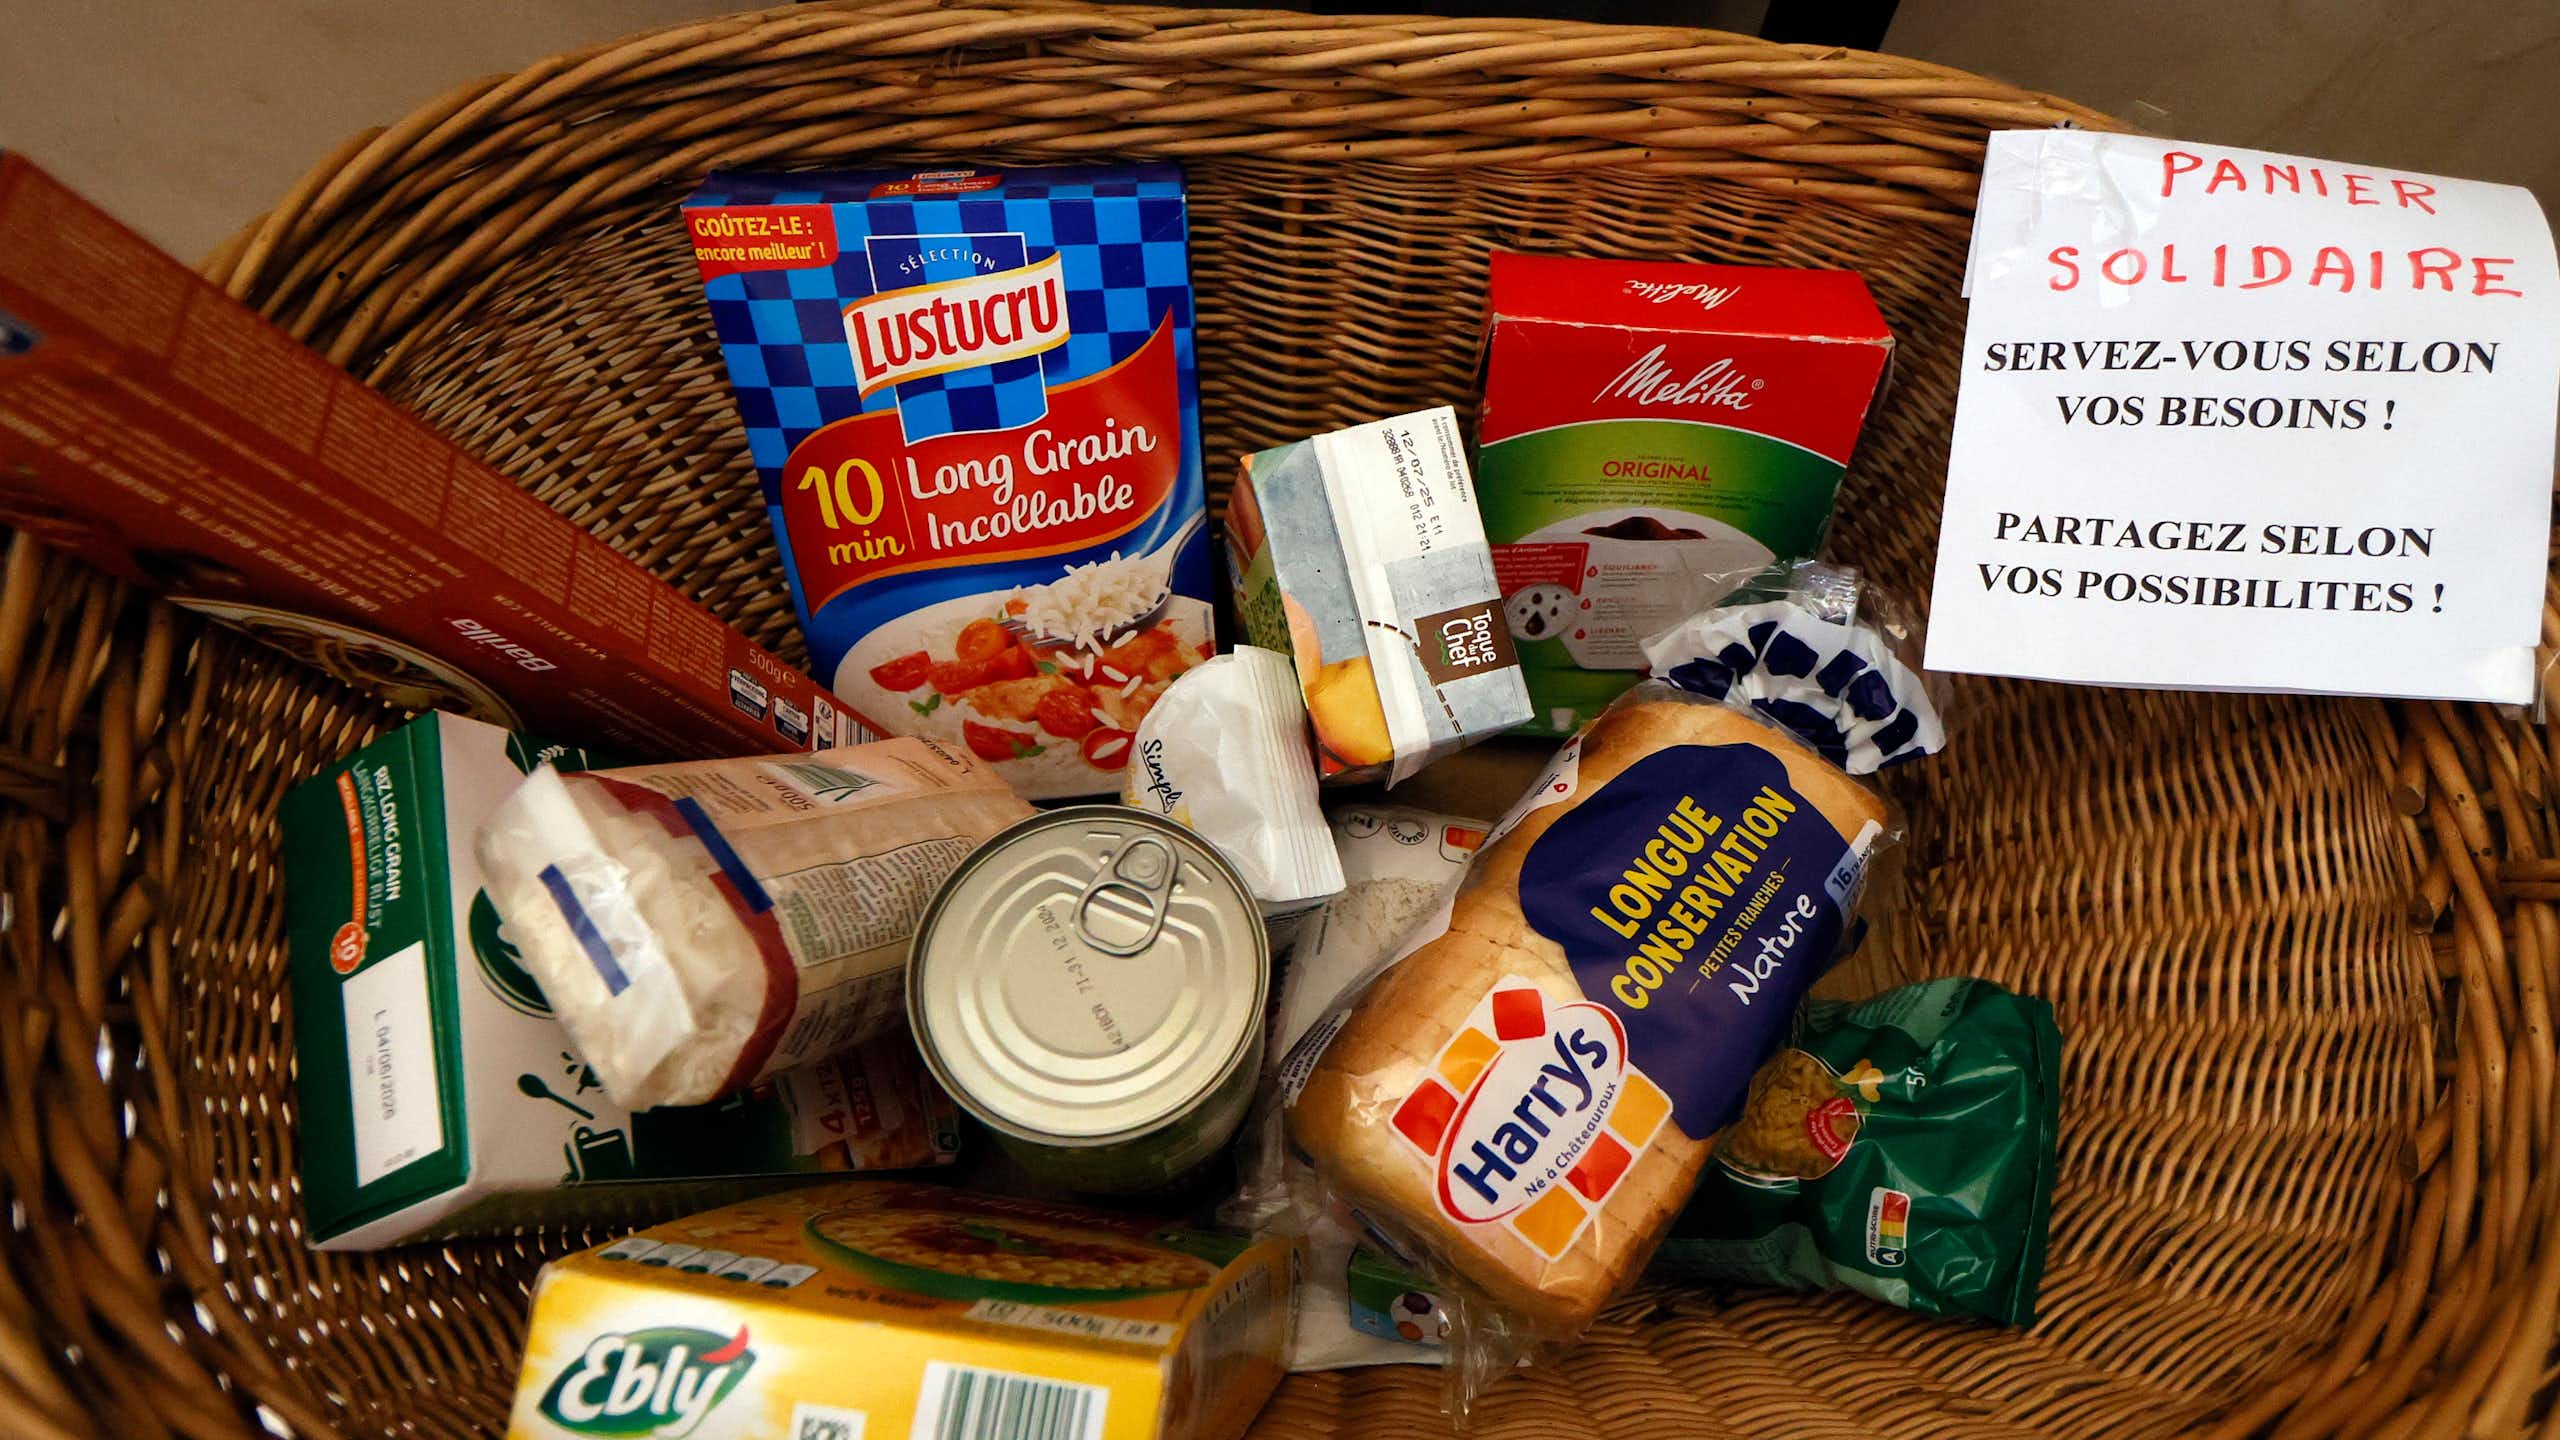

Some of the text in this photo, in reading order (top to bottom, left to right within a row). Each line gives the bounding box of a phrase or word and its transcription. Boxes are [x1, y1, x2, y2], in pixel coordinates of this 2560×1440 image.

[2161, 151, 2437, 215] PANIER
[694, 215, 803, 238] GOÛTEZ-LE
[695, 245, 745, 262] encore
[899, 248, 997, 275] SÉLECTION
[2048, 245, 2523, 297] SOLIDAIRE
[1625, 280, 1742, 311] Melitta
[1593, 343, 1753, 411] Melitta
[1984, 340, 2501, 375] SERVEZ-VOUS SELON
[2056, 396, 2397, 431] VOS BESOINS !
[905, 417, 1157, 505] Long Grain
[1401, 430, 1435, 507] 12/07/25
[1602, 460, 1712, 482] ORIGINAL
[797, 458, 885, 530] 10
[926, 474, 1135, 551] Incollable
[827, 530, 905, 567] min
[1994, 513, 2437, 558] PARTAGEZ SELON
[1976, 564, 2446, 615] VOS POSSIBILITES !
[451, 618, 558, 672] Barilla
[1442, 618, 1481, 668] Chef
[1468, 644, 1479, 656] du
[1472, 608, 1497, 663] Toque
[380, 793, 402, 842] LONG
[385, 841, 402, 901] GRAIN
[1590, 795, 1723, 939] LONGUE
[1831, 866, 1853, 893] 16
[1610, 785, 1797, 1010] CONSERVATION
[1698, 870, 1786, 980] PETITES TRANCHES
[1728, 894, 1817, 1006] Nature
[1453, 1028, 1608, 1205] Harrys
[1525, 1081, 1618, 1197] Né à Châteauroux
[557, 1334, 731, 1438] Ebly
